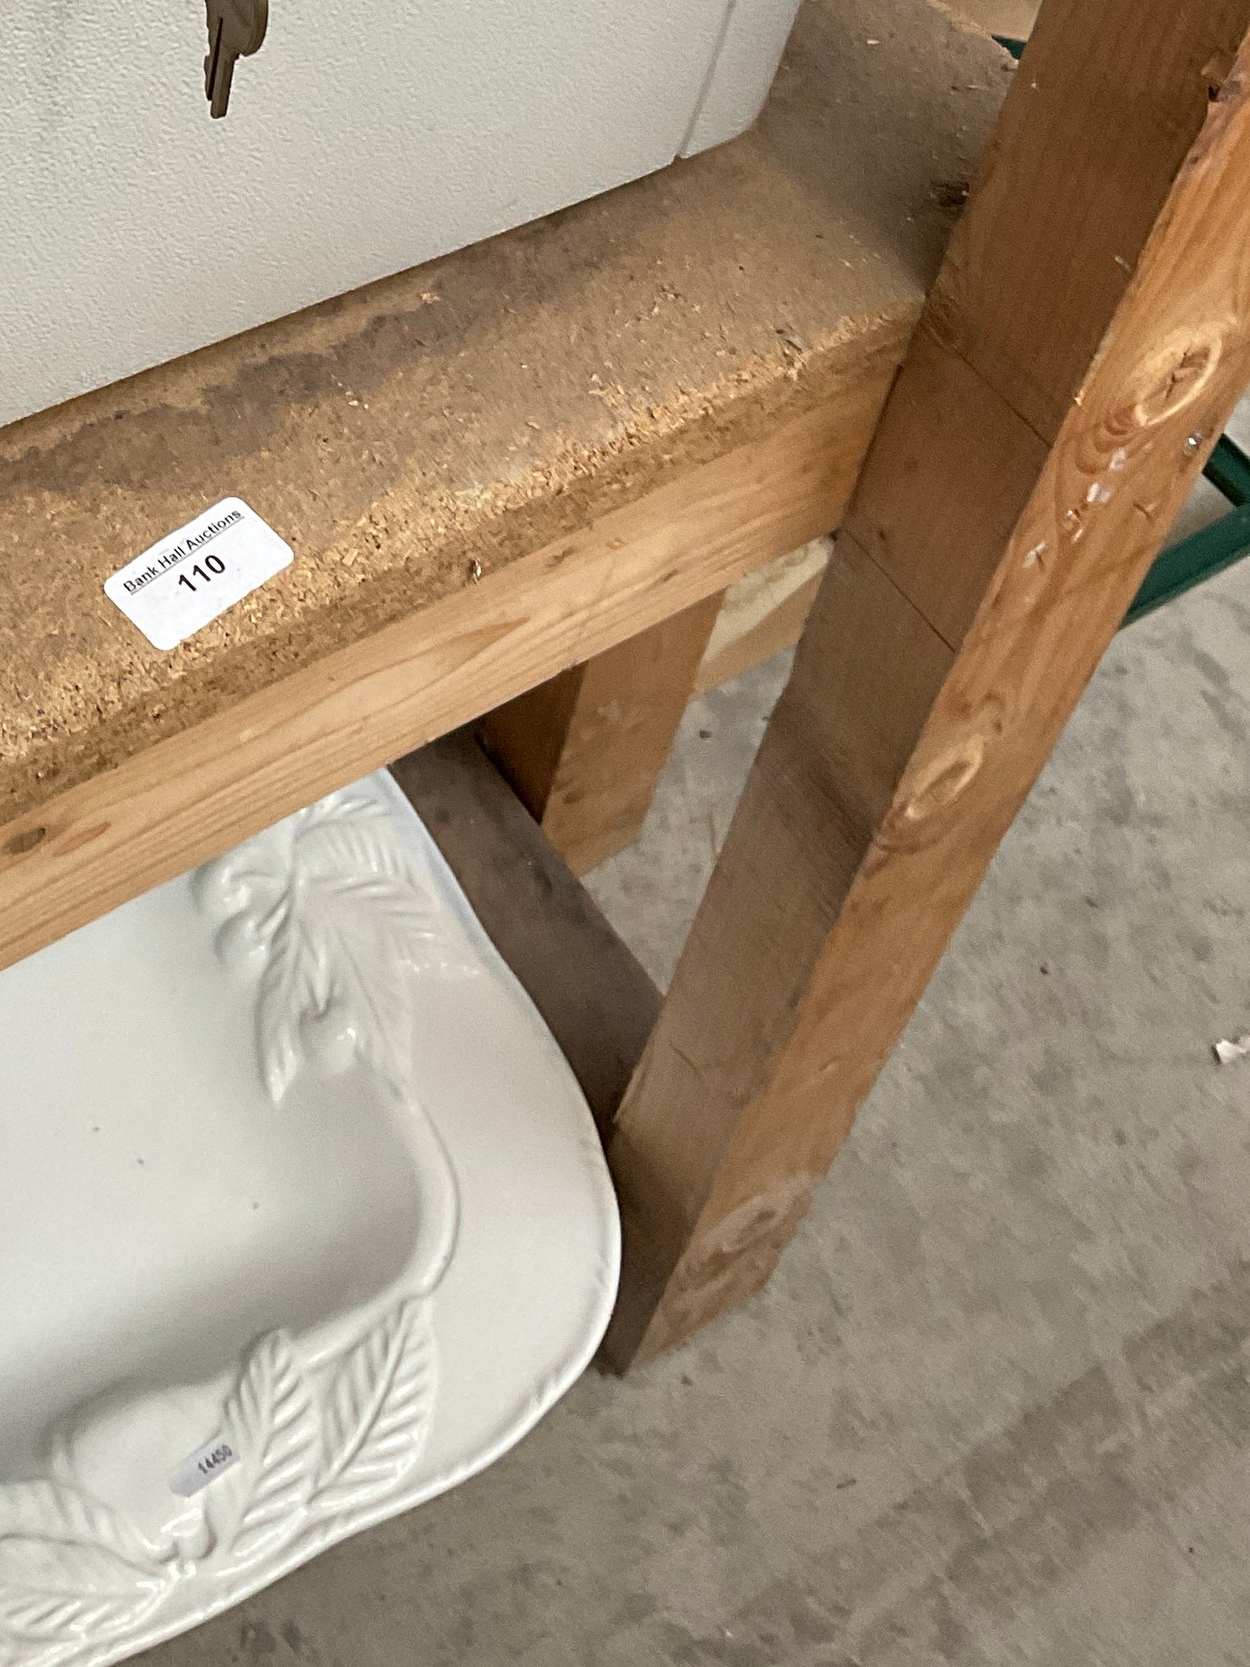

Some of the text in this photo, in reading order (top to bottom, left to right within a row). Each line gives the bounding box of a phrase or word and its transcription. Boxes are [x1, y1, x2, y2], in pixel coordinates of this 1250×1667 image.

[123, 510, 242, 593] Bank Hall Auctions
[178, 554, 226, 592] 110
[198, 1444, 232, 1474] 14450
